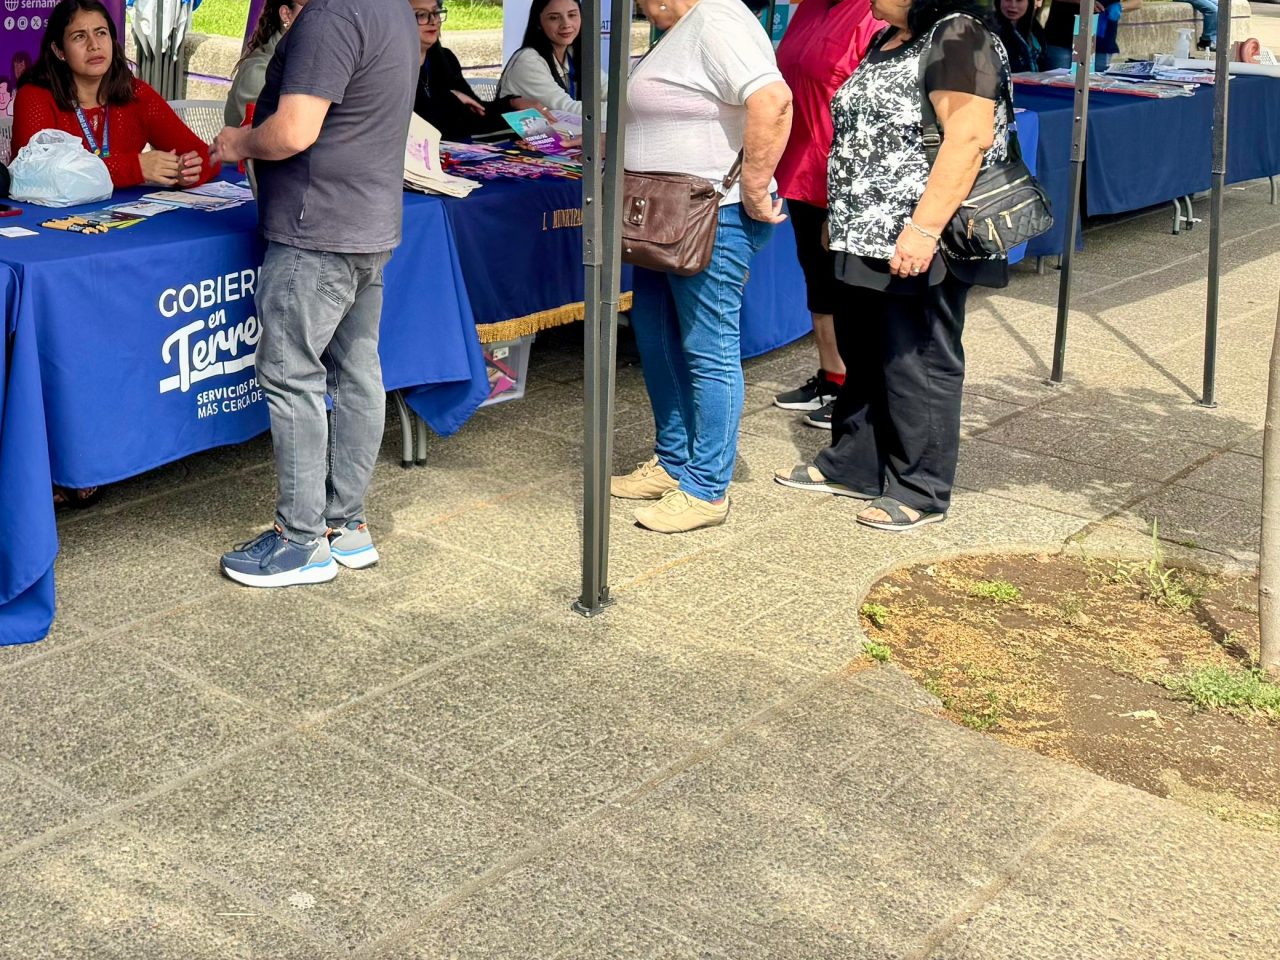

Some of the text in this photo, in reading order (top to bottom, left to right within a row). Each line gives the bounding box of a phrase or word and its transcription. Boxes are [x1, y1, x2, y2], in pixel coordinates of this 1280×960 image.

[208, 309, 226, 328] en
[196, 381, 248, 405] SERVICIOS
[222, 395, 251, 413] CERCA
[251, 389, 263, 403] DE
